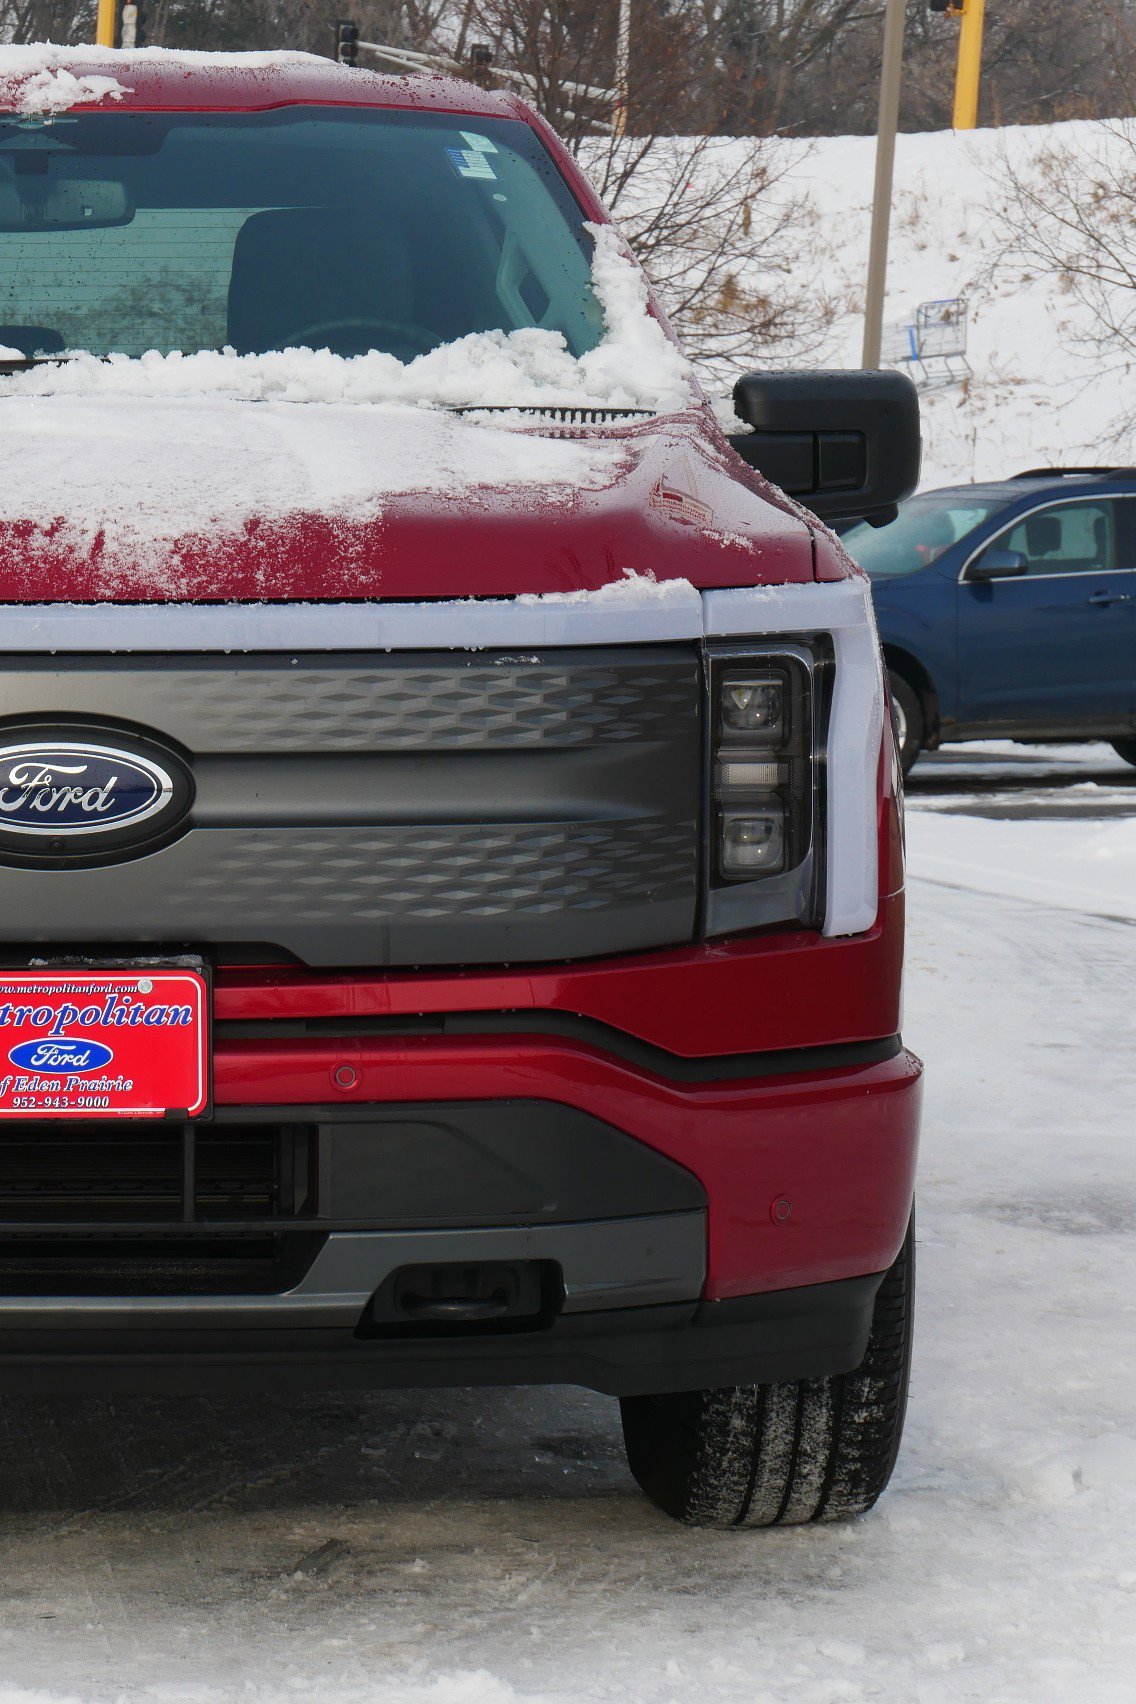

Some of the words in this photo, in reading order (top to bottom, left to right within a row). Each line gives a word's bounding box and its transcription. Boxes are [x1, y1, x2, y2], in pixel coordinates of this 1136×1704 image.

[30, 1043, 91, 1067] Ford
[12, 1075, 61, 1092] Eden
[65, 1075, 133, 1092] Prairie
[12, 1096, 110, 1108] 952-943-9000
